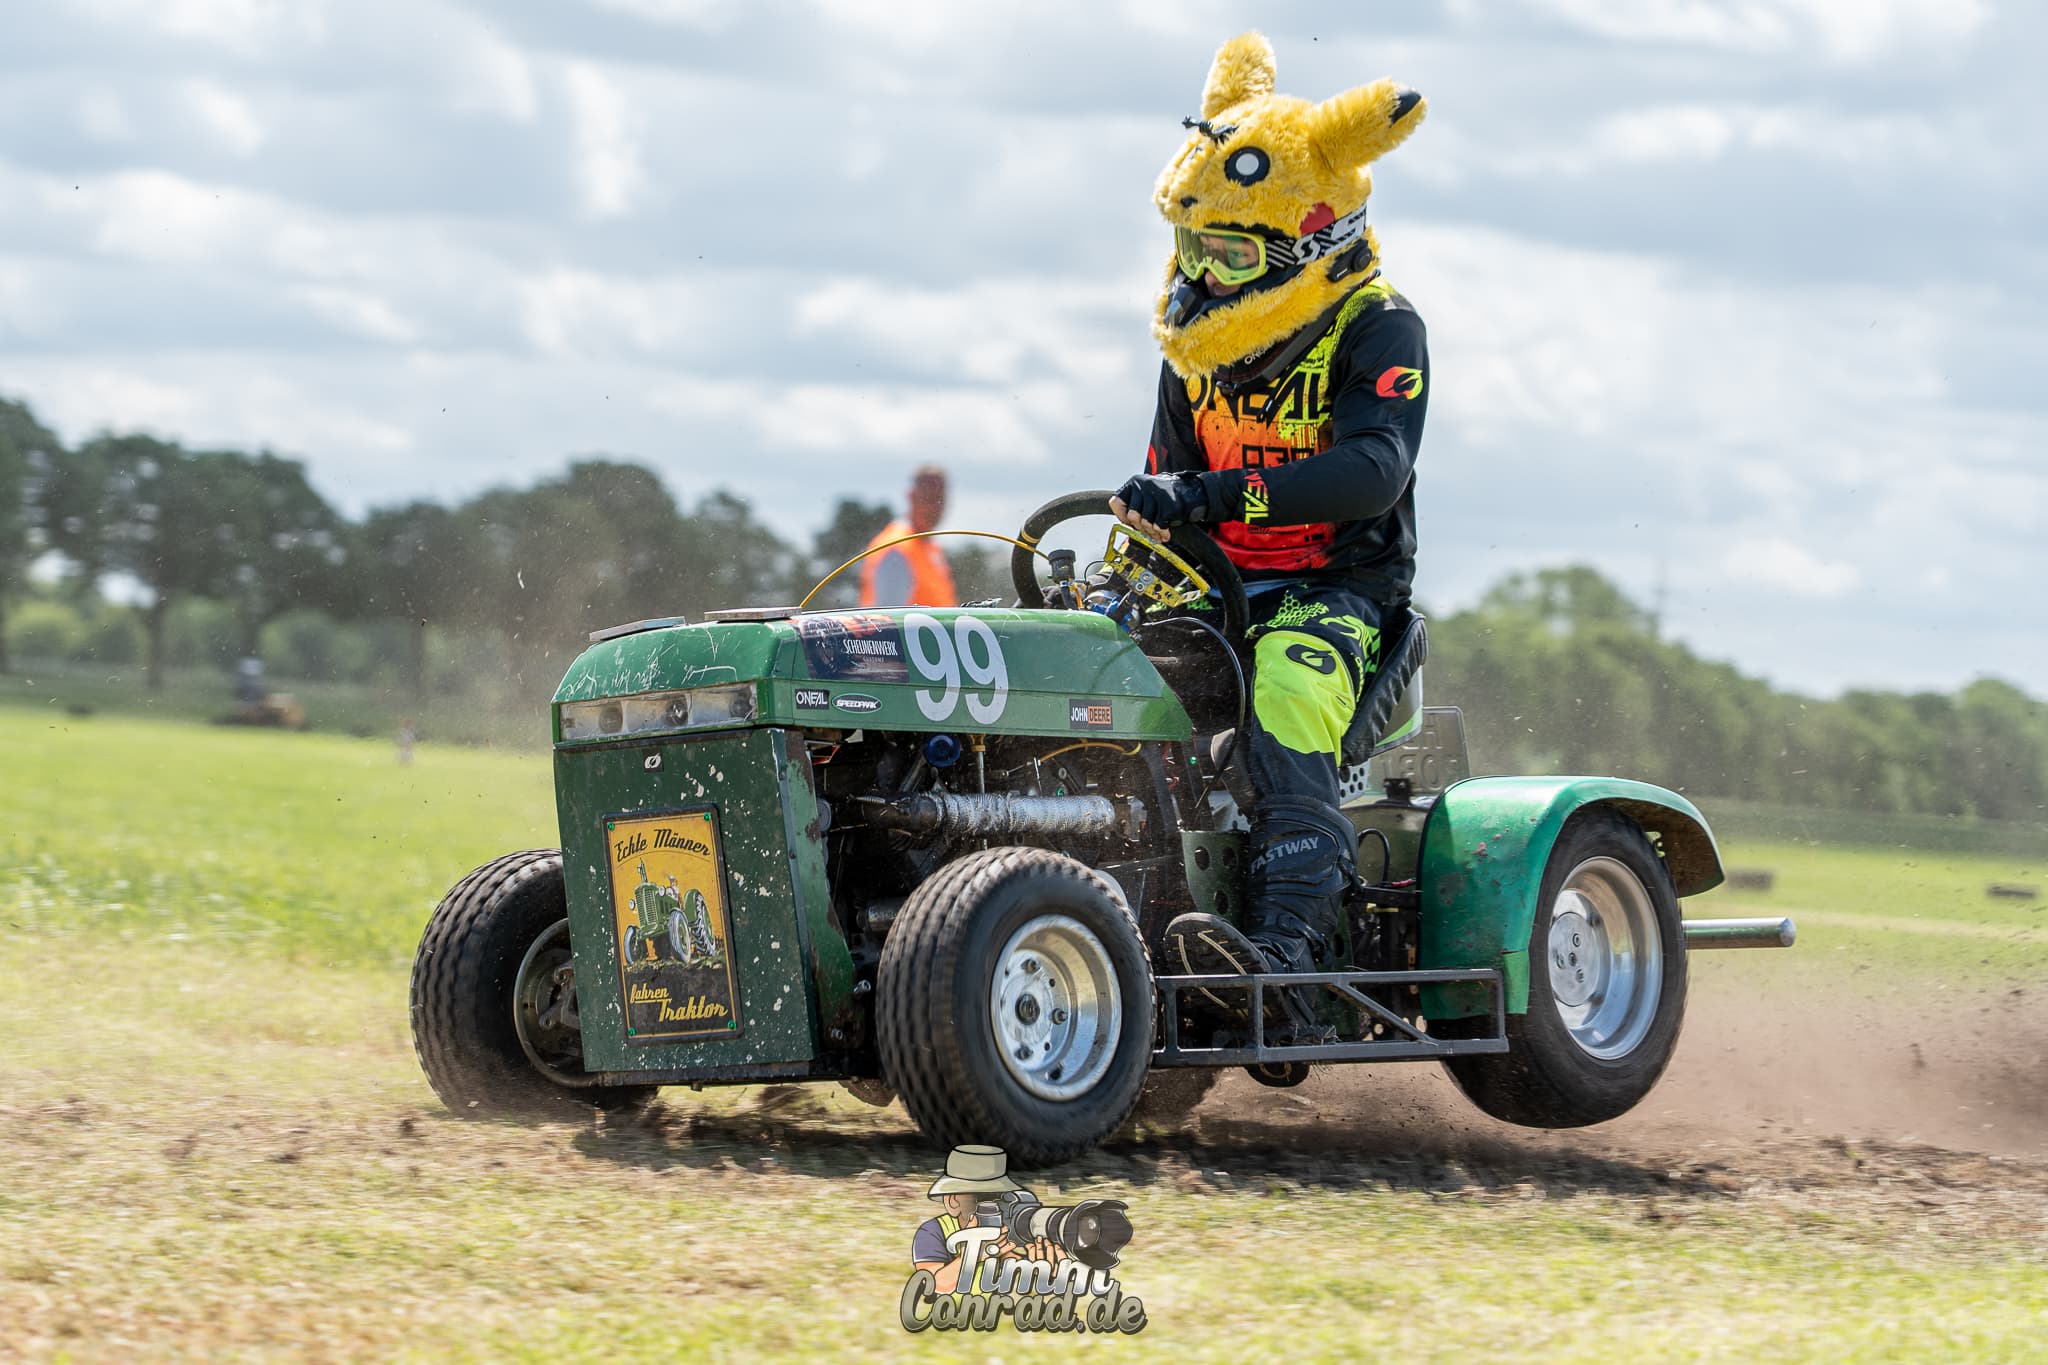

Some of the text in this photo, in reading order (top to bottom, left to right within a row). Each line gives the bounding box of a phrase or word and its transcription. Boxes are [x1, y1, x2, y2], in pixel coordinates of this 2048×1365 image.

[842, 638, 899, 657] SCHEUNENWERK
[903, 612, 1009, 725] 99
[796, 690, 828, 708] ONEAL
[1070, 706, 1111, 723] JOHN DEERE
[654, 828, 711, 857] Männer
[630, 982, 670, 1004] fahren
[656, 994, 729, 1022] Traktor
